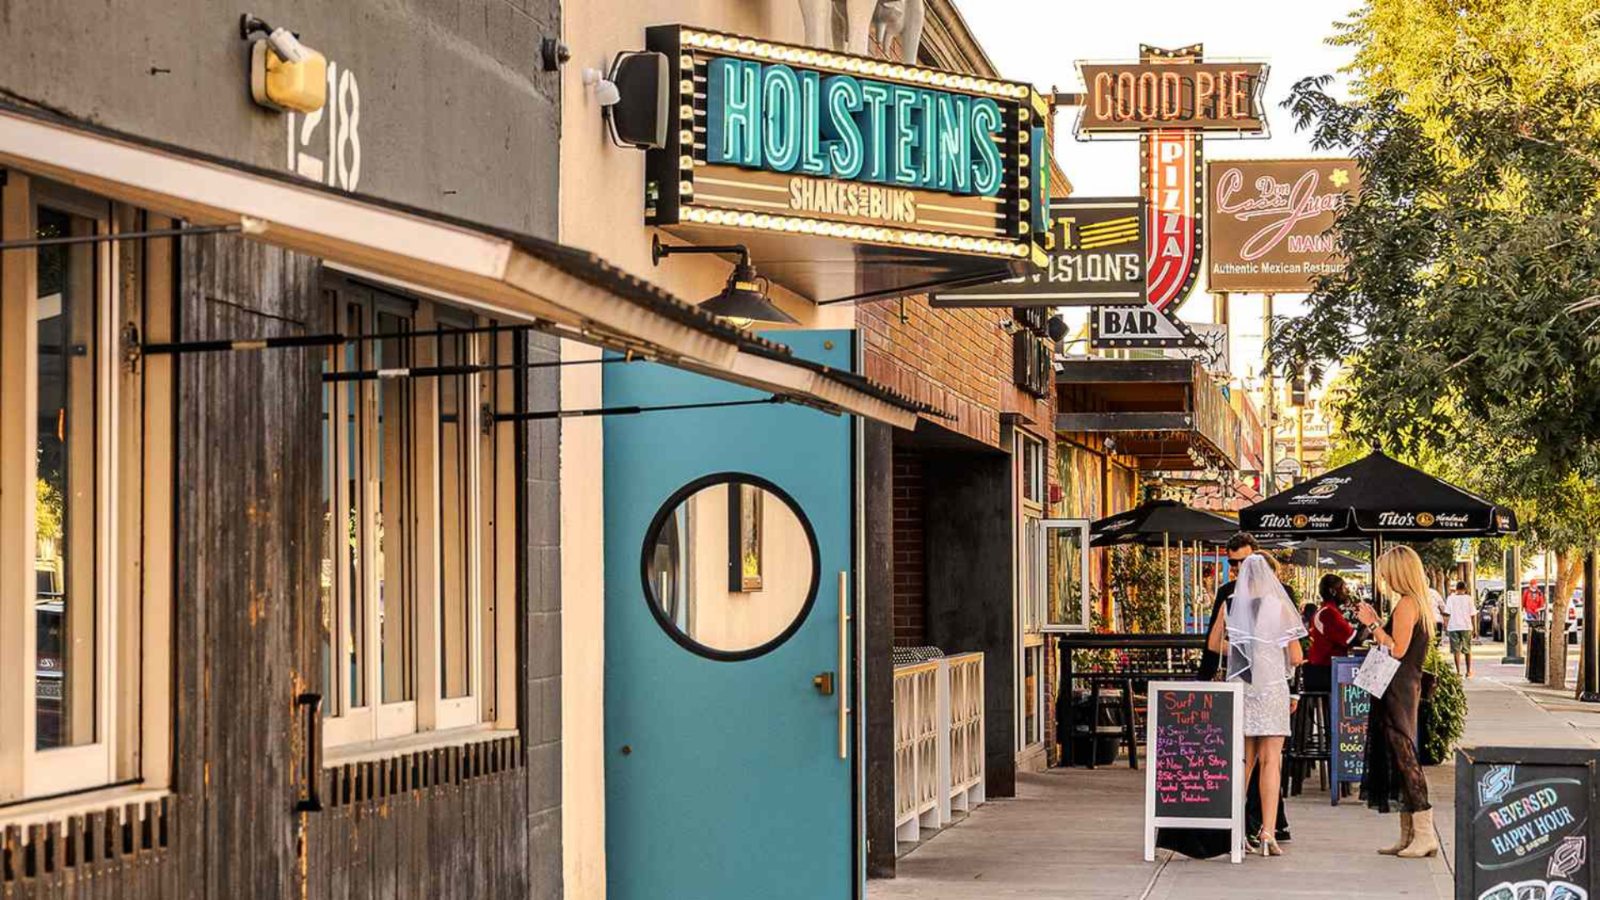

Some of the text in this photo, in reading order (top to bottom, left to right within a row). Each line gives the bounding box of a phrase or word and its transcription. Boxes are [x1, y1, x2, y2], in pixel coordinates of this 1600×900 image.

[1094, 69, 1249, 121] GOOD PIE
[708, 57, 1003, 196] HOLSTEINS
[1255, 175, 1291, 198] Don
[788, 177, 916, 224] SHAKES AND BUNS
[1161, 142, 1184, 258] PIZZA
[1288, 235, 1333, 253] MAIN
[1213, 262, 1259, 274] Authentic
[1261, 261, 1301, 273] Mexican
[1104, 311, 1158, 335] BAR
[1259, 513, 1293, 529] Tito's
[1378, 511, 1415, 527] Tito's
[1164, 691, 1213, 710] Surf N
[1489, 787, 1558, 830] REVERSED
[1491, 806, 1576, 855] HAPPY HOUR
